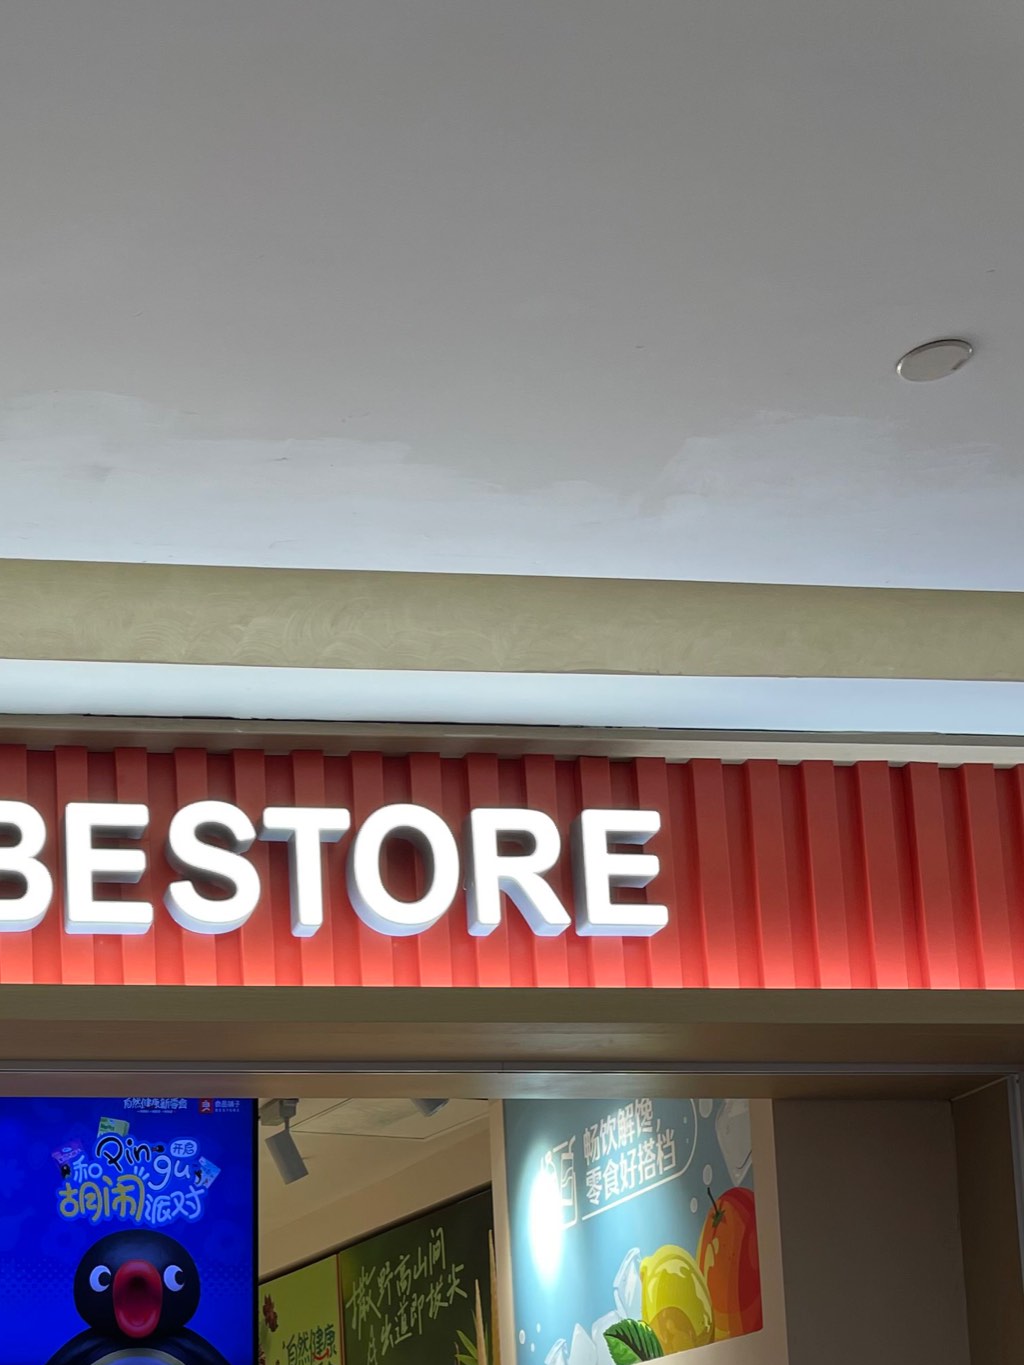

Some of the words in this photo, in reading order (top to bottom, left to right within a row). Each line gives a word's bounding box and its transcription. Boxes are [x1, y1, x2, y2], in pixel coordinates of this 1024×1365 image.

[173, 1141, 196, 1155] 开启
[586, 1128, 677, 1205] 零食好搭档
[73, 1155, 103, 1183] 和
[59, 1173, 145, 1222] 胡闹
[145, 1185, 205, 1224] 派对
